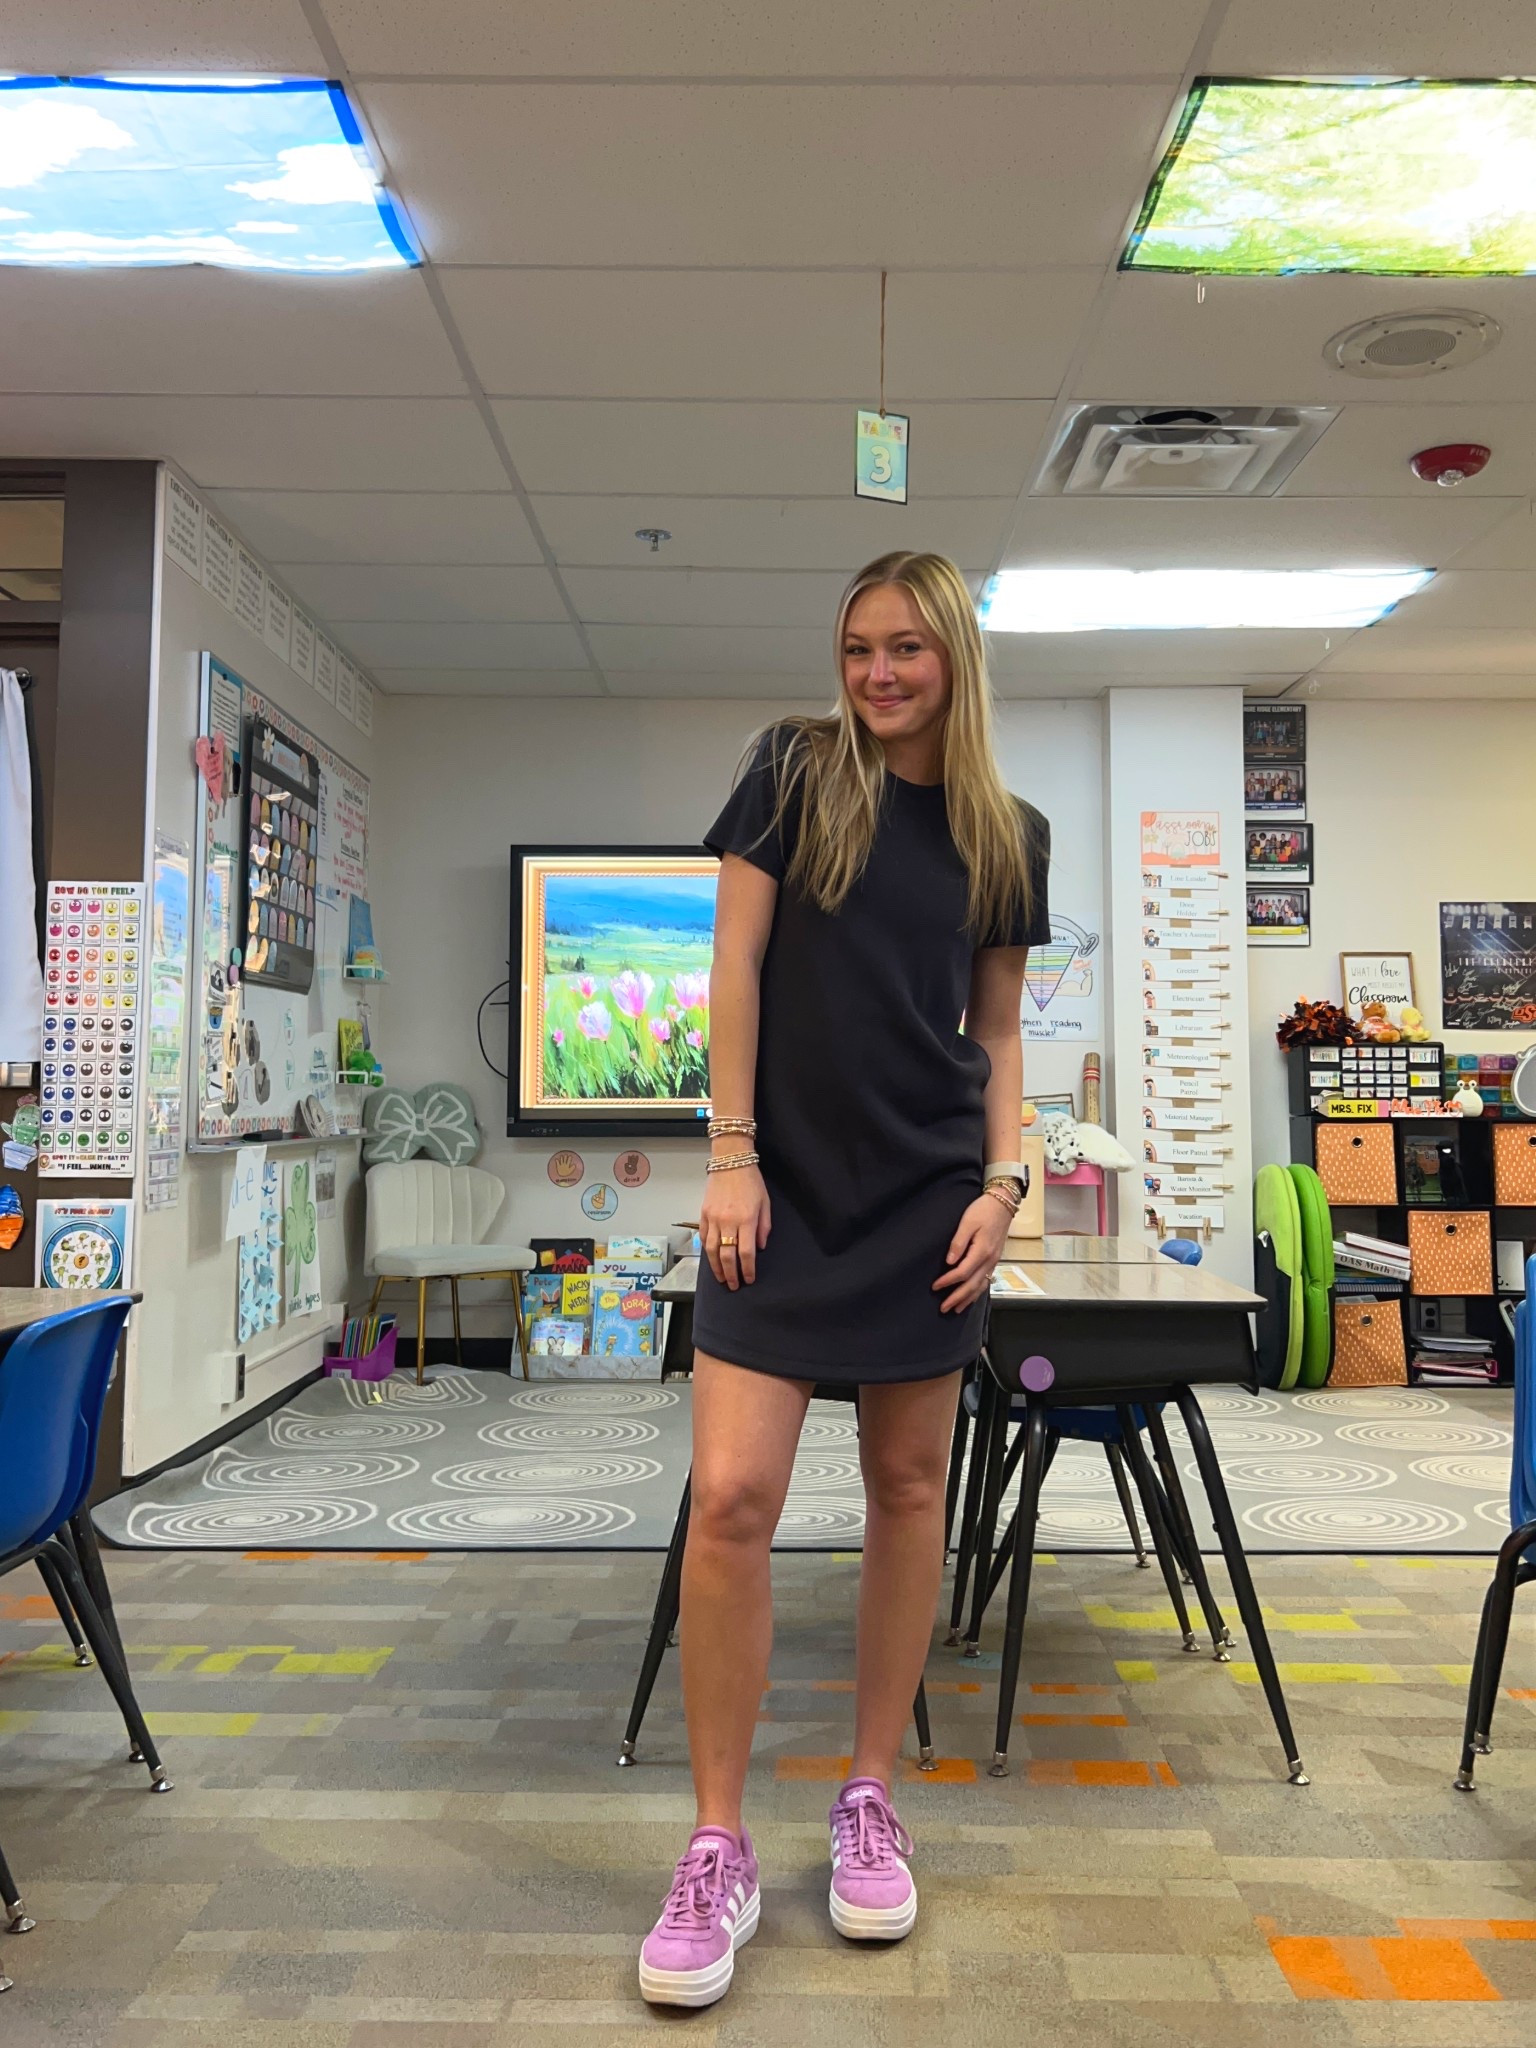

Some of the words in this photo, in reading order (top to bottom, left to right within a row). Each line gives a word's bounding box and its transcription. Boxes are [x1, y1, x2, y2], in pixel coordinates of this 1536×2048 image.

[870, 445, 893, 484] 3
[1184, 831, 1217, 847] JOBS
[1185, 875, 1207, 883] Leader
[55, 886, 75, 895] HOW
[77, 886, 89, 895] DO
[91, 886, 108, 895] YOU
[1176, 967, 1199, 975] Greeter
[1351, 967, 1370, 977] WHAT
[1380, 960, 1402, 978] love
[1349, 986, 1409, 1005] Classroom
[1051, 1018, 1082, 1031] reading
[1028, 1028, 1057, 1037] muscles!
[1166, 1053, 1209, 1062] Meteorologist
[1331, 1104, 1354, 1114] MRS.
[1358, 1104, 1373, 1114] FIX
[1164, 1113, 1188, 1121] Material
[1189, 1114, 1214, 1122] Manager
[1340, 1255, 1363, 1267] OAS
[1364, 1261, 1391, 1274] Math
[533, 1277, 553, 1286] Pete
[640, 1275, 662, 1285] CAT
[567, 1280, 590, 1295] WACKY
[305, 1293, 321, 1310] types
[622, 1298, 650, 1312] LORAX
[845, 1788, 873, 1802] adidas
[691, 1840, 720, 1850] adidas
